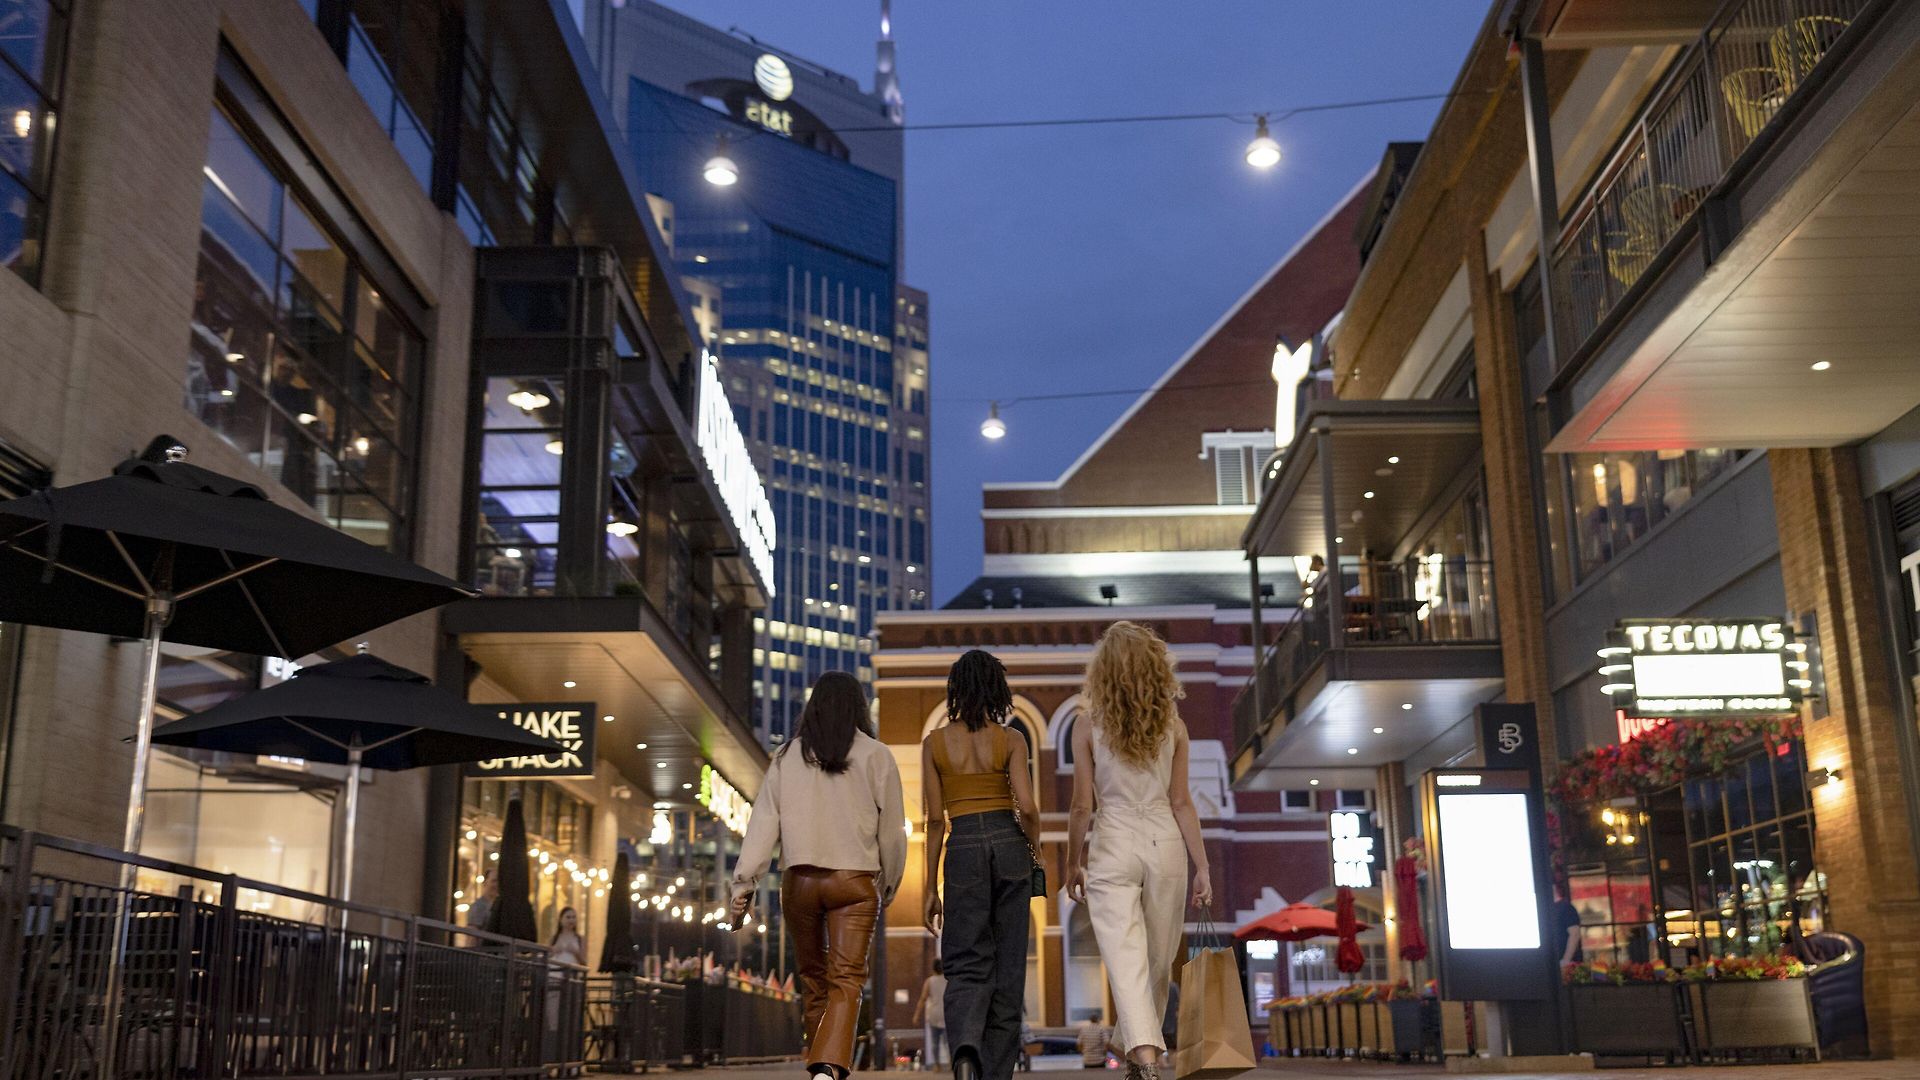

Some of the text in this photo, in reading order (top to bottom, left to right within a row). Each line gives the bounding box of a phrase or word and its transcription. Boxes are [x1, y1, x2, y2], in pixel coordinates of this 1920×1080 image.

[745, 100, 793, 135] at&t
[1625, 623, 1785, 651] TECOVAS
[498, 710, 581, 739] AKE
